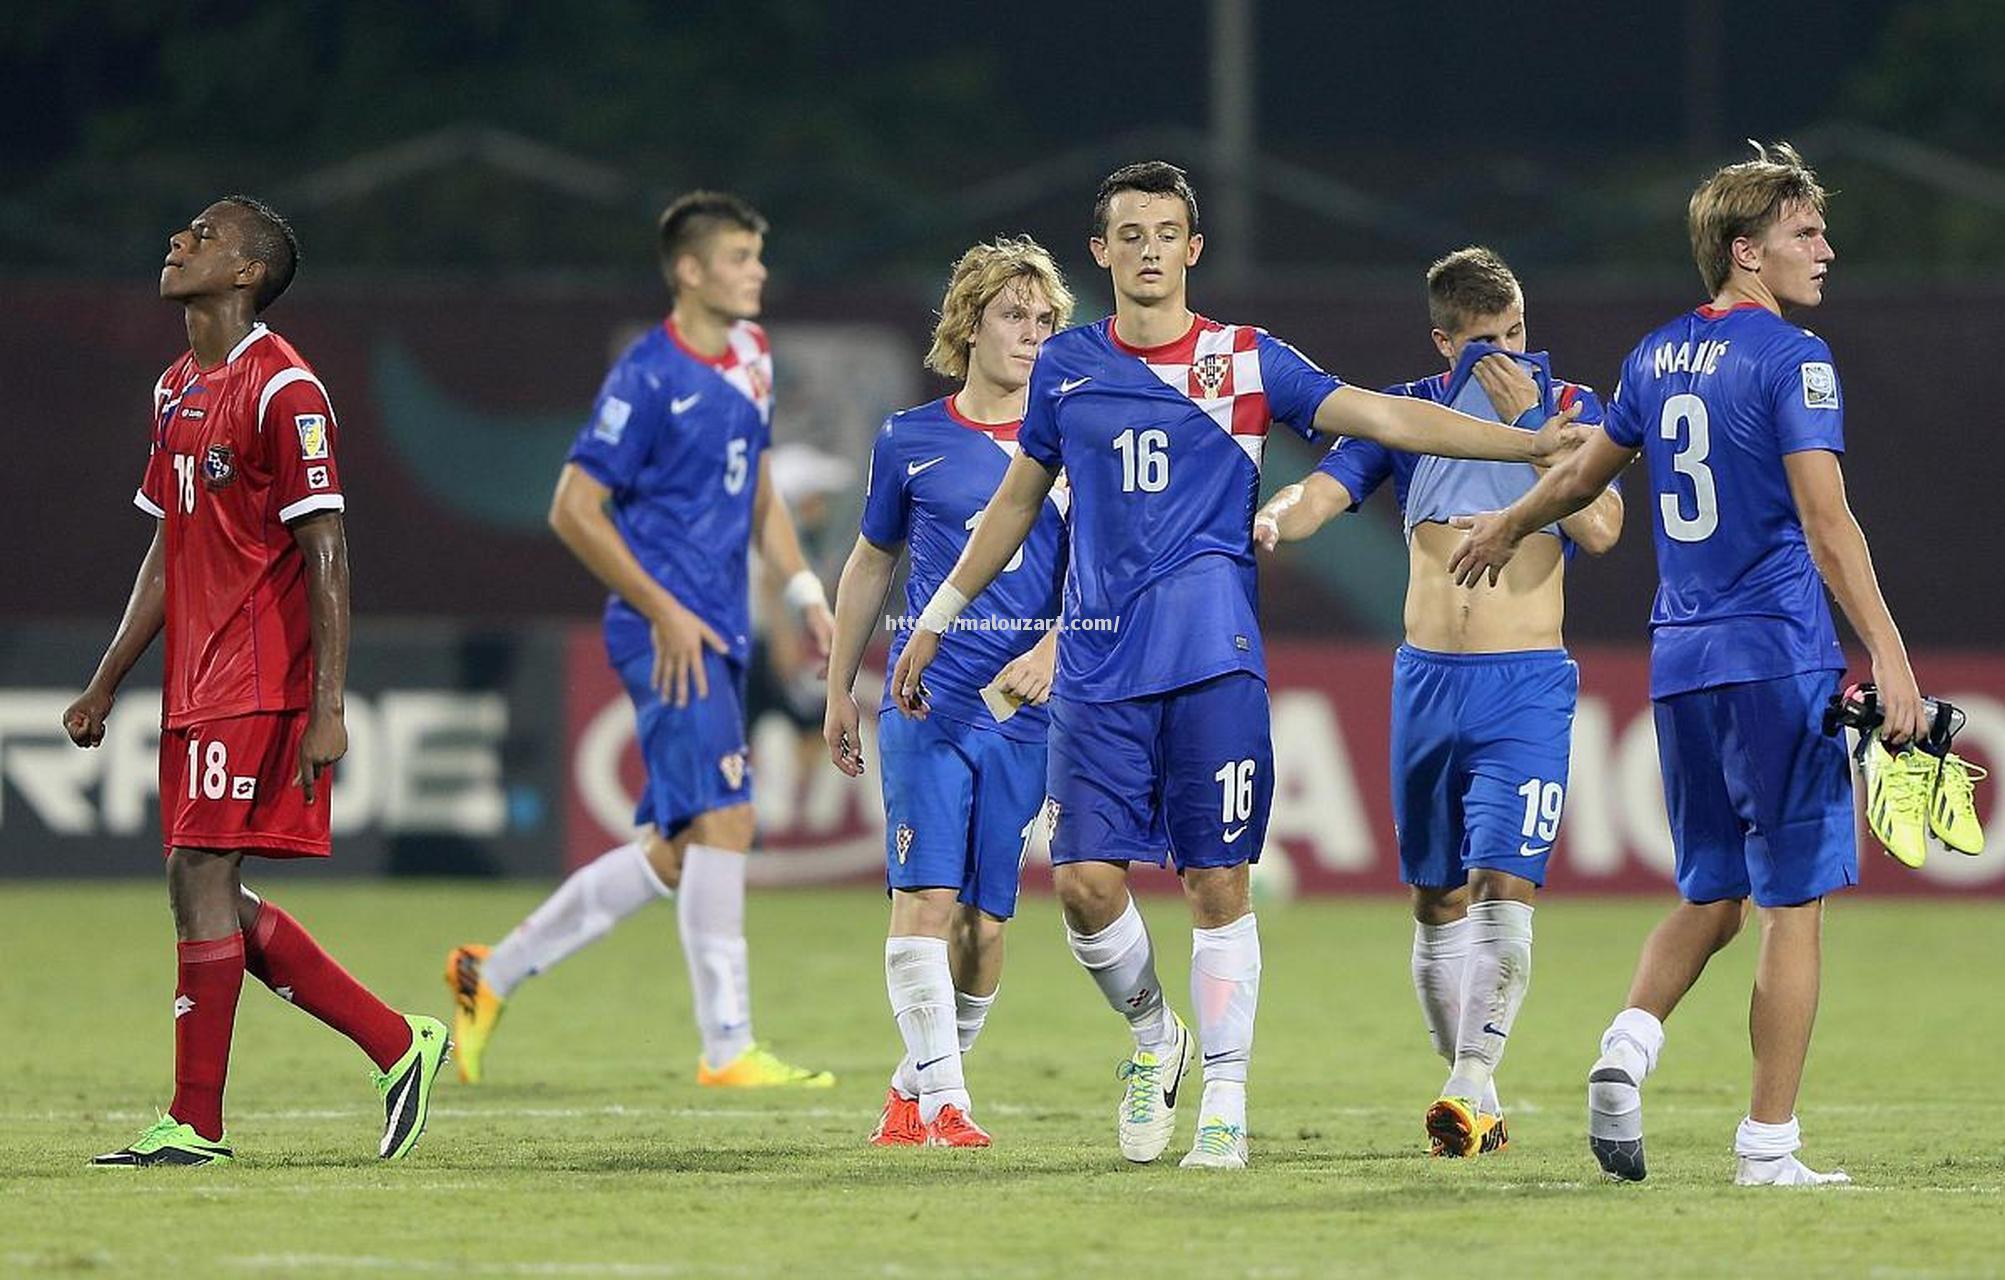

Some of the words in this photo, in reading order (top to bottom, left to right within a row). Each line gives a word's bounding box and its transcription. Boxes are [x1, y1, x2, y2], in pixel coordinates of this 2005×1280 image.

[173, 453, 195, 515] 18
[723, 437, 748, 496] 5
[1113, 428, 1169, 493] 16
[1660, 393, 1719, 542] 3
[188, 740, 227, 800] 18
[1215, 759, 1256, 824] 16
[1518, 778, 1563, 842] 19
